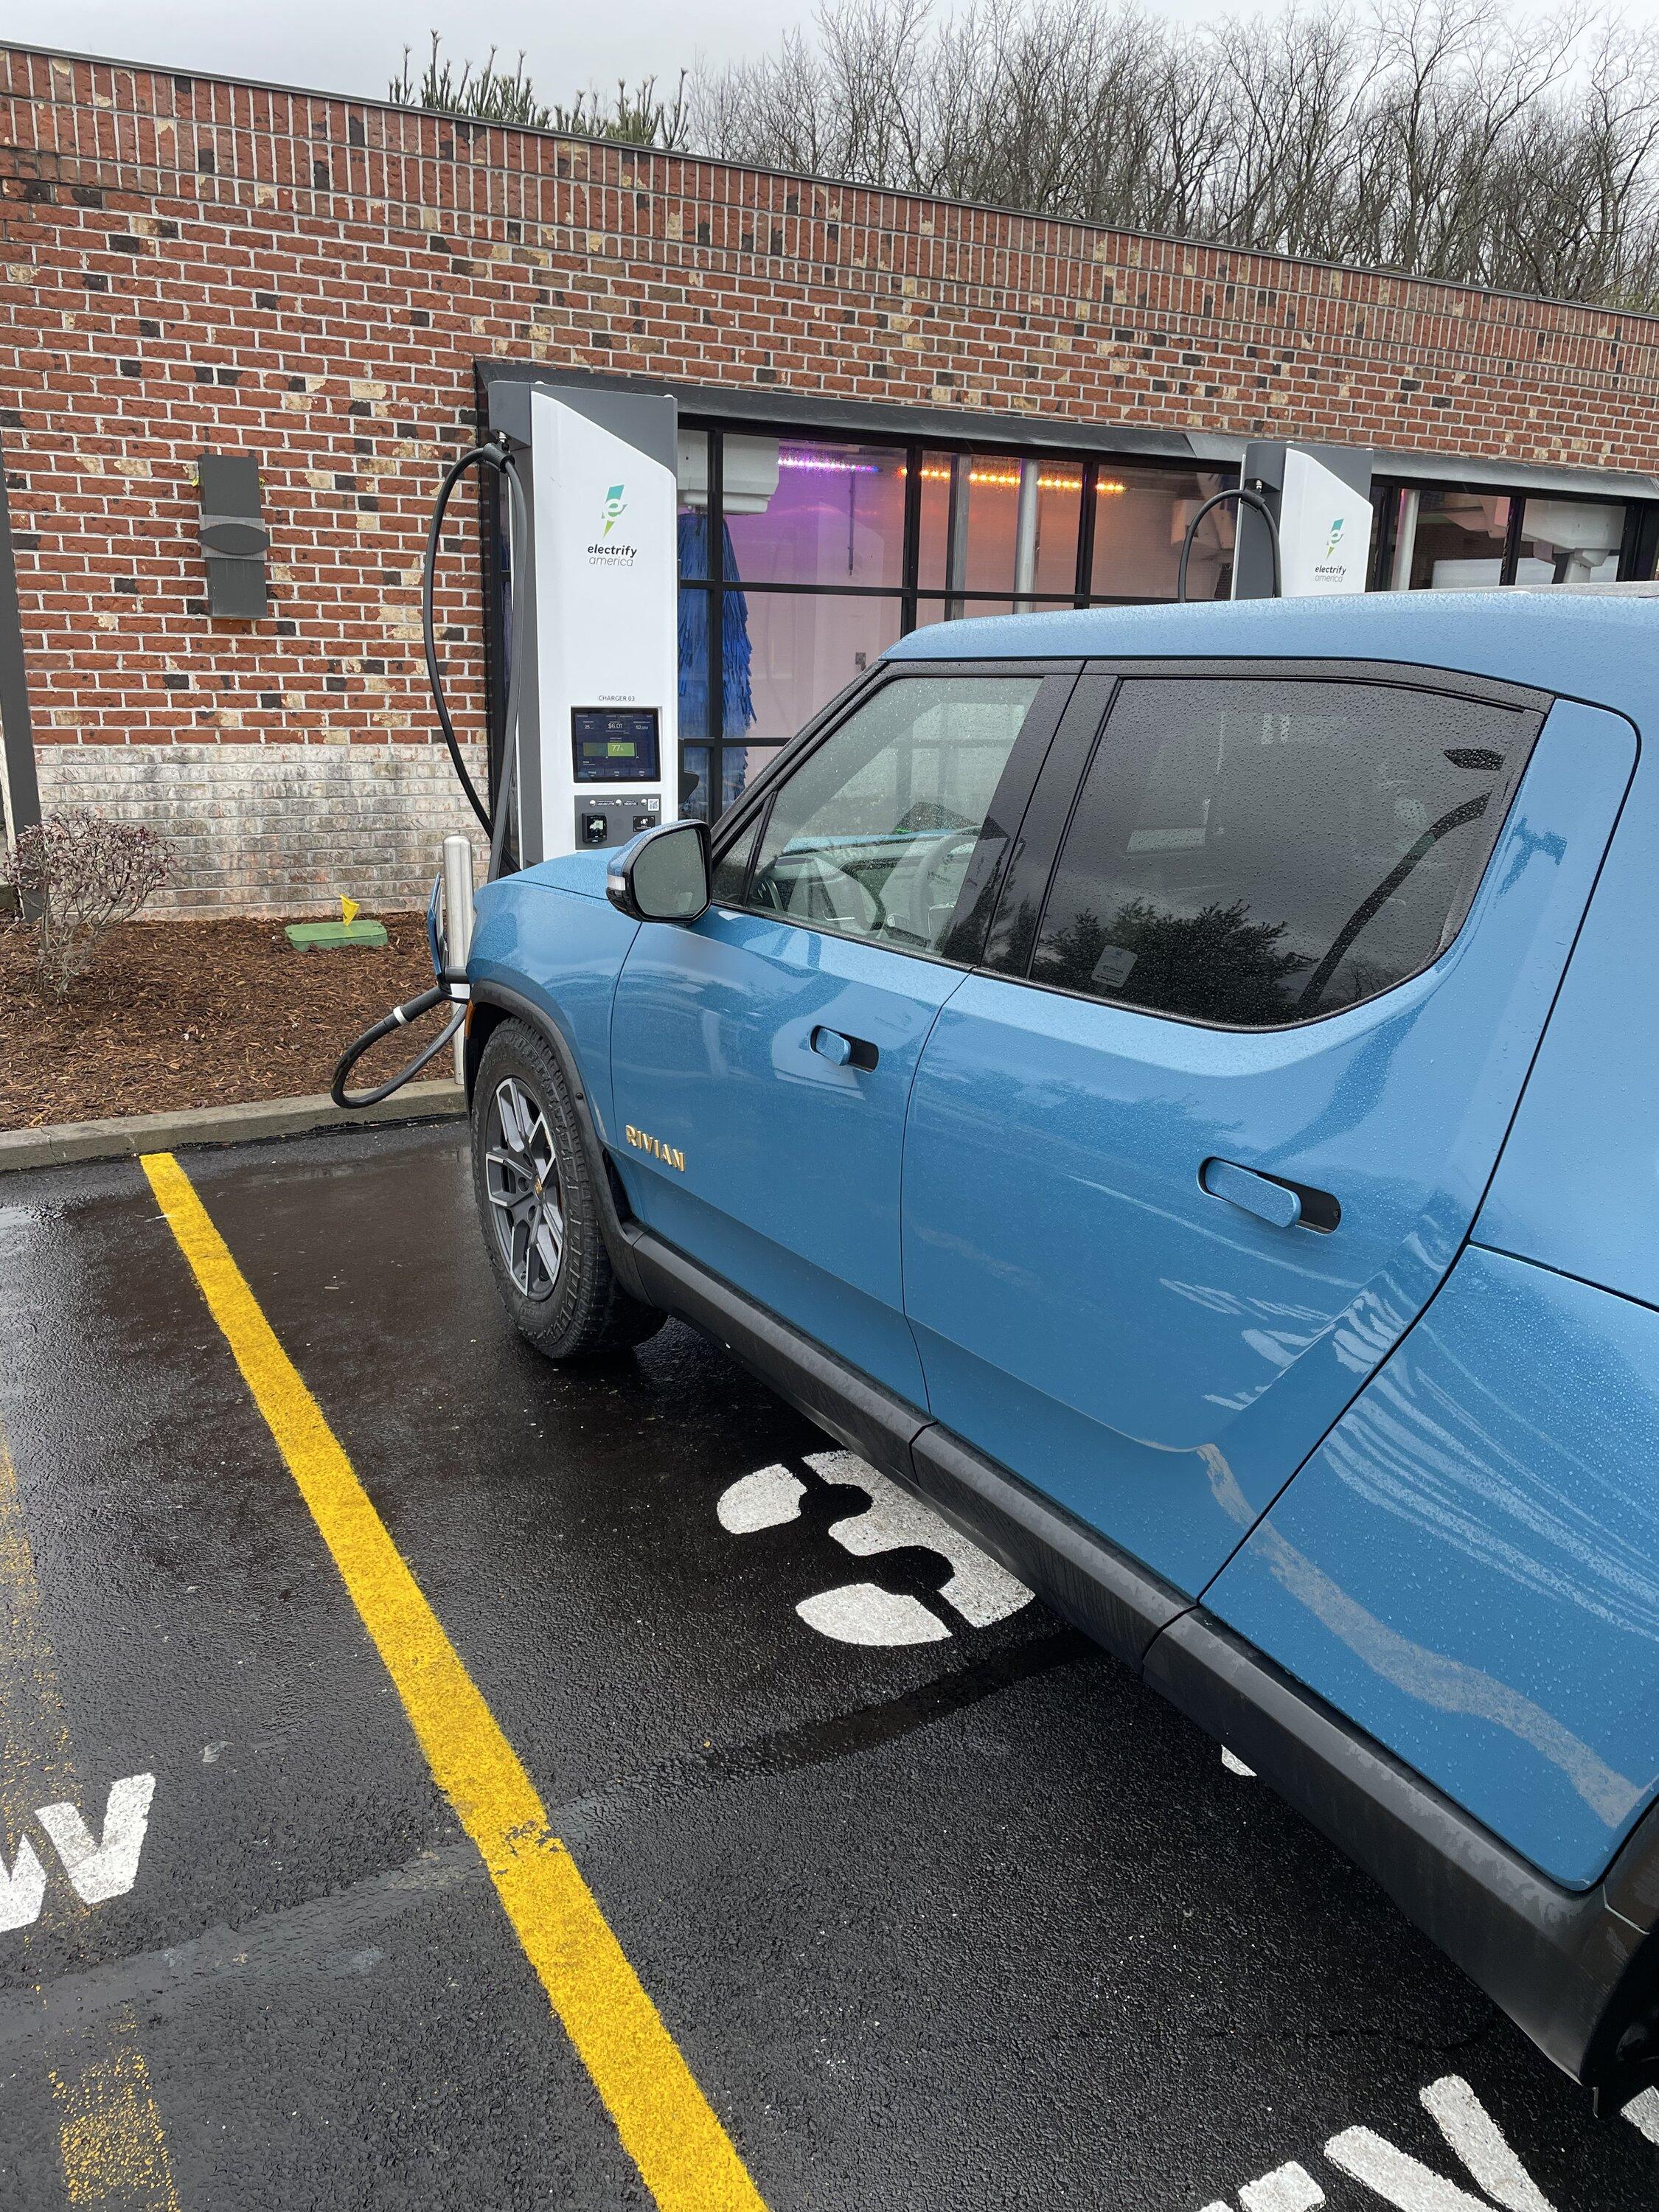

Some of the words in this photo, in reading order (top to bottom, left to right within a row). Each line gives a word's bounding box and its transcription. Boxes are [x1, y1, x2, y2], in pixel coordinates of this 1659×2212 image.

[588, 543, 637, 557] electrify
[588, 557, 634, 567] america
[1315, 565, 1347, 576] electrify
[1315, 574, 1343, 582] america
[625, 1124, 685, 1172] RIVIAN
